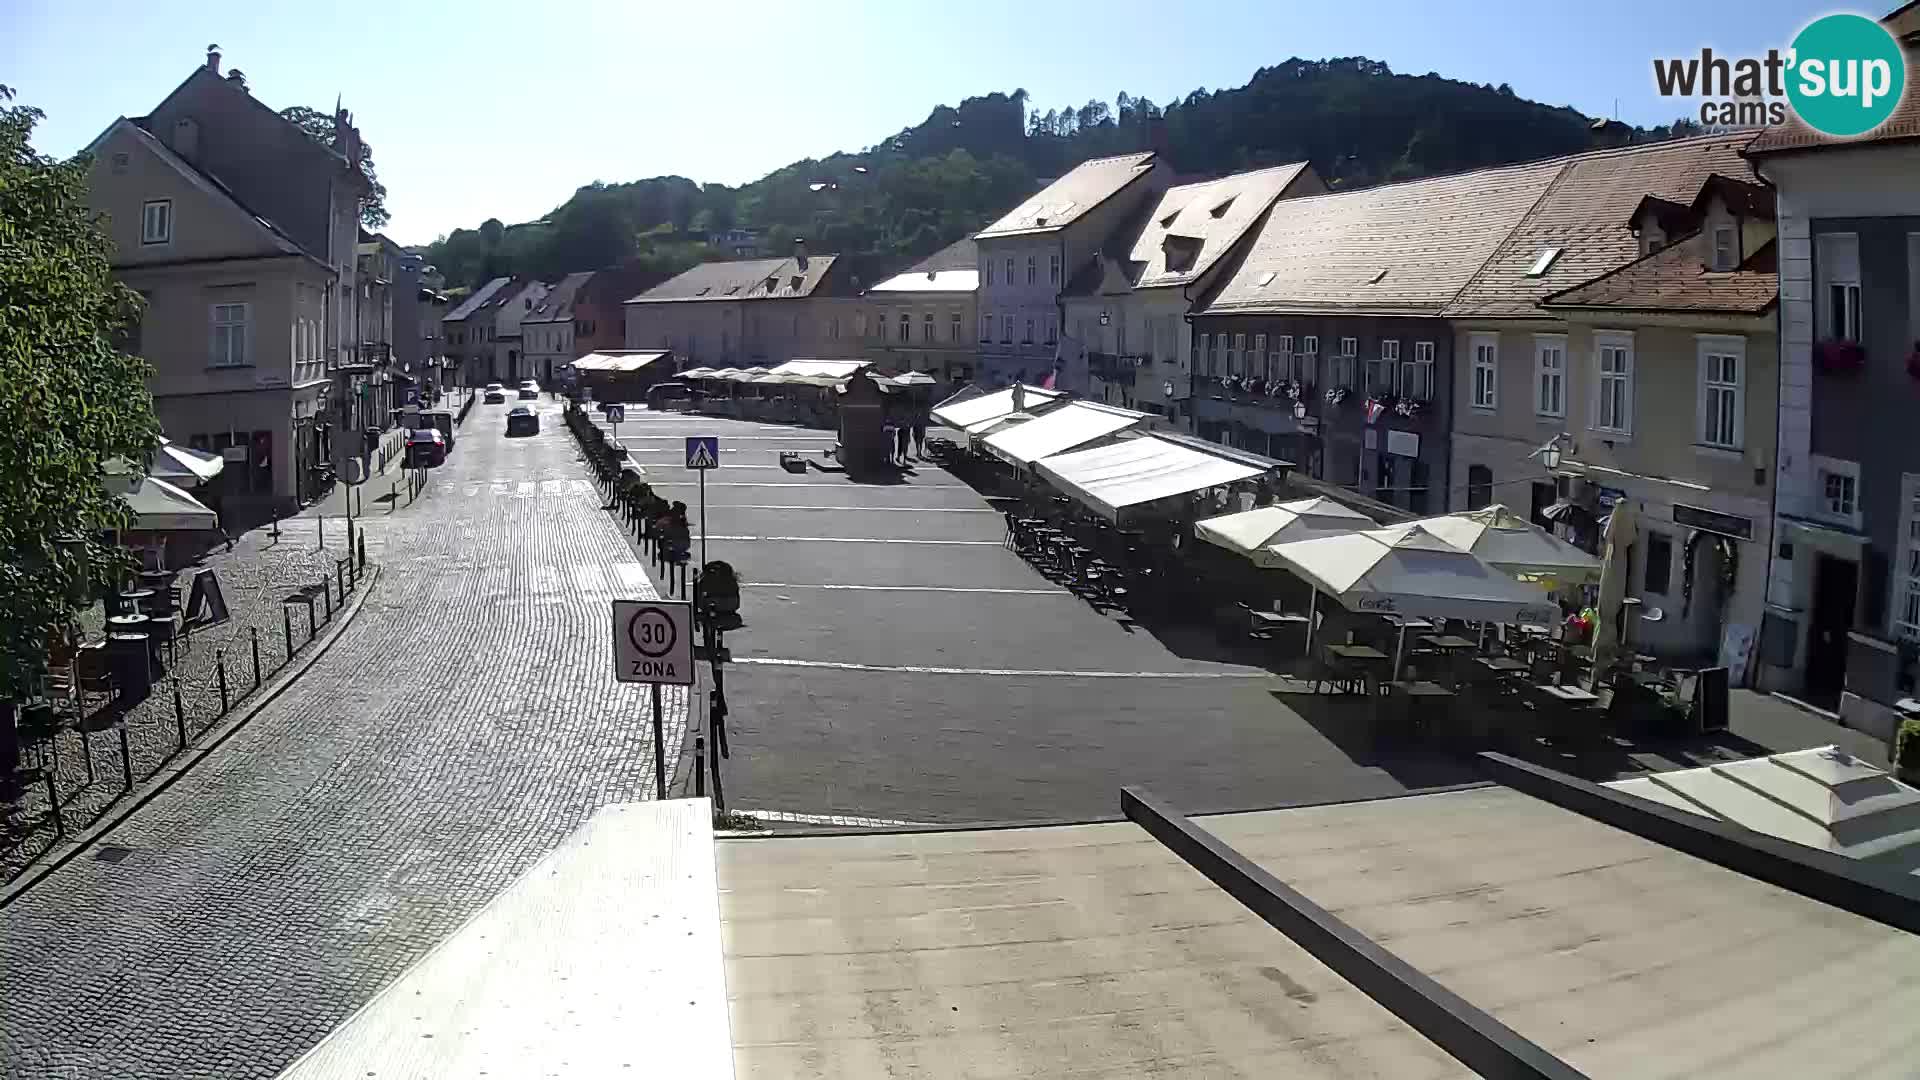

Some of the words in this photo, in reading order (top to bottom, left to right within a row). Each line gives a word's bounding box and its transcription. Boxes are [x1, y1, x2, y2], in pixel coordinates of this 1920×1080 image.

[407, 391, 415, 402] P
[641, 623, 665, 644] 30
[631, 660, 676, 677] ZONA
